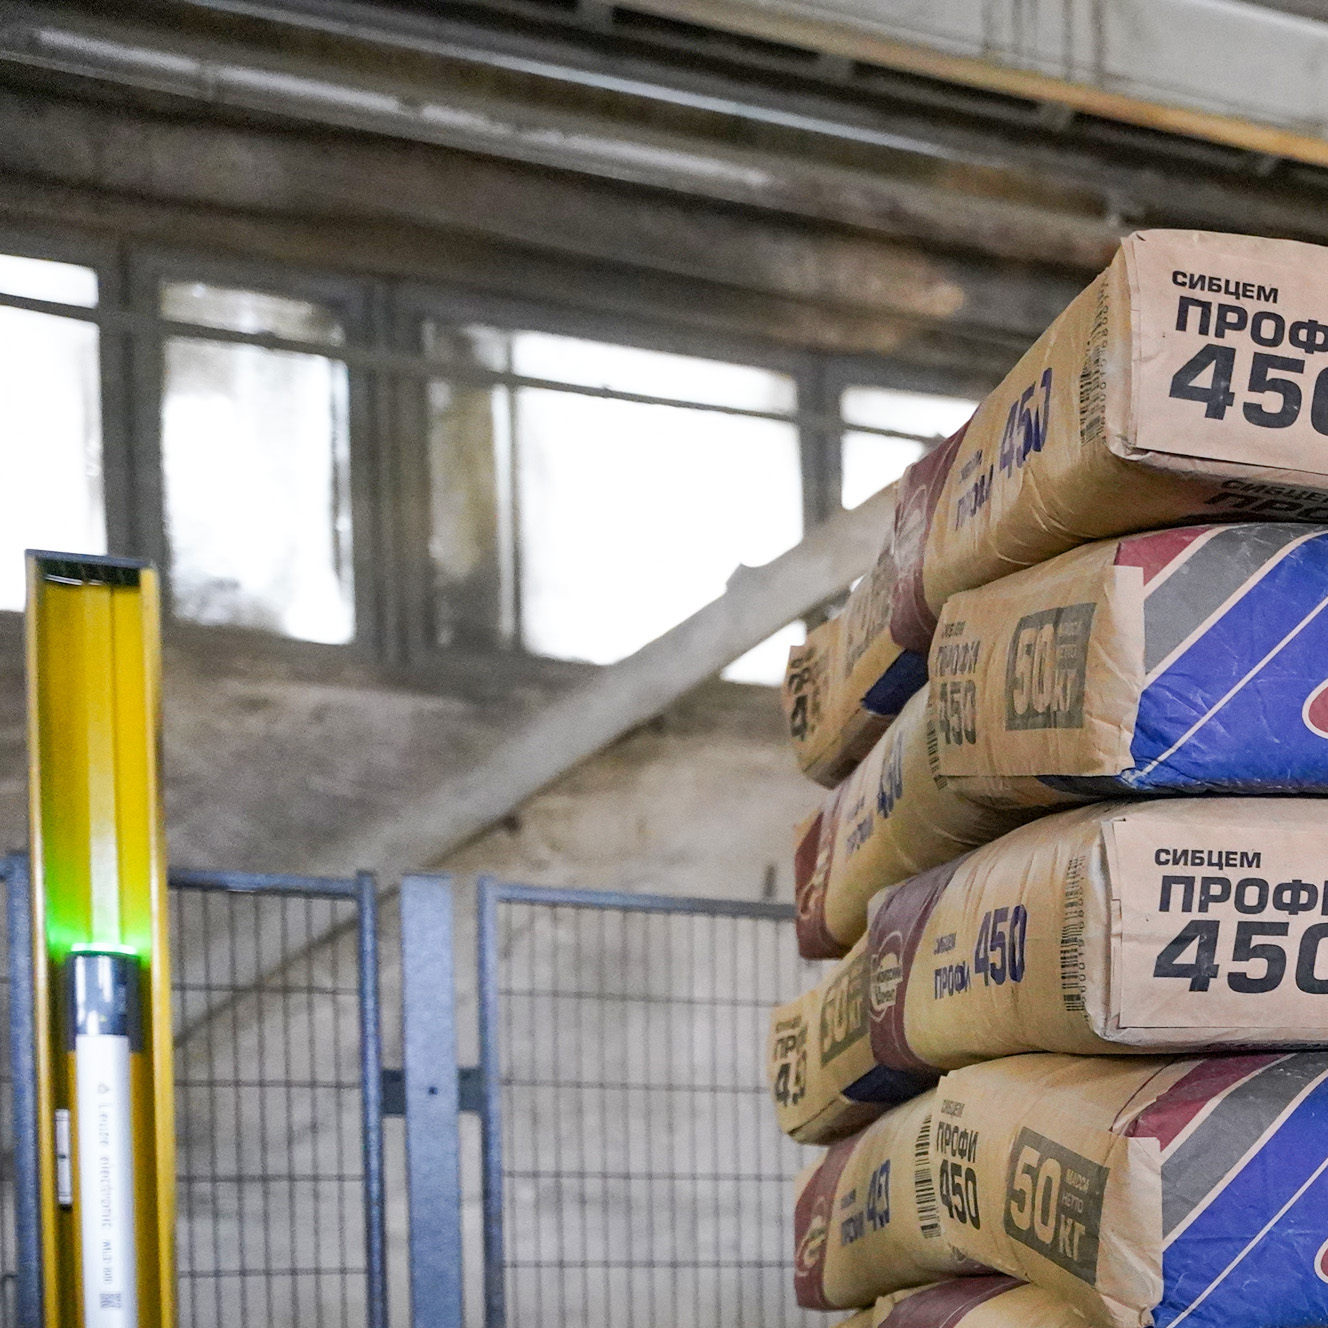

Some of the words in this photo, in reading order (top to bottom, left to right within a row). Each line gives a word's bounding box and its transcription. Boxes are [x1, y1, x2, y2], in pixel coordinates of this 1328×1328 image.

[1172, 270, 1279, 303] СИБЦЕМ
[1154, 848, 1262, 869] СИБЦЕМ
[975, 904, 1027, 986] 450
[937, 1121, 978, 1163] ПРОФИ
[940, 1160, 980, 1230] 450
[1010, 1146, 1061, 1244] 50
[1059, 1214, 1086, 1261] КГ
